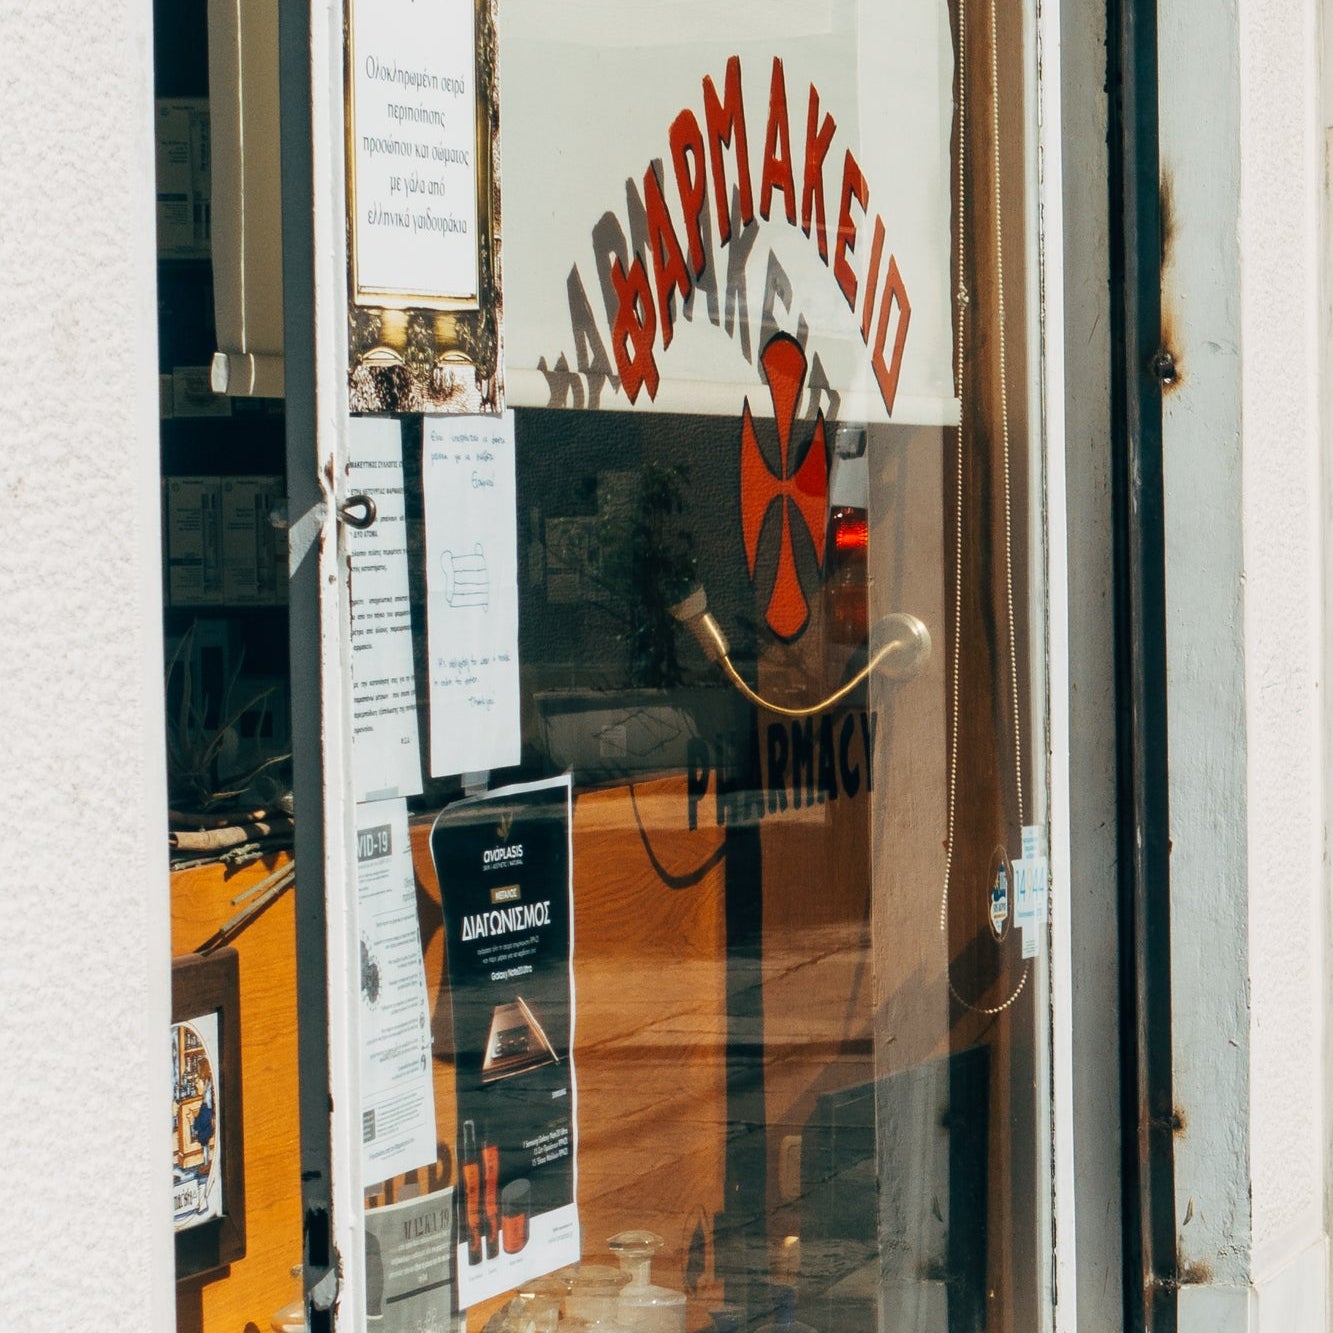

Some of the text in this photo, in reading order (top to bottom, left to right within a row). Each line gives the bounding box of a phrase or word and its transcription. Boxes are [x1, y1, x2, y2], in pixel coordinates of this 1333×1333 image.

[365, 55, 465, 98] Ολοκληρωμένη σειρά
[387, 102, 446, 129] περιποίησης
[362, 133, 469, 167] προσώπου και σώματος
[389, 169, 446, 198] με γάλα από
[367, 200, 410, 229] ελληνικά
[611, 55, 911, 418] ΦΑΡΜΑΚΕΙΟ
[462, 900, 551, 941] ΔΙΑΓΩΝΙΣΜΟΣ
